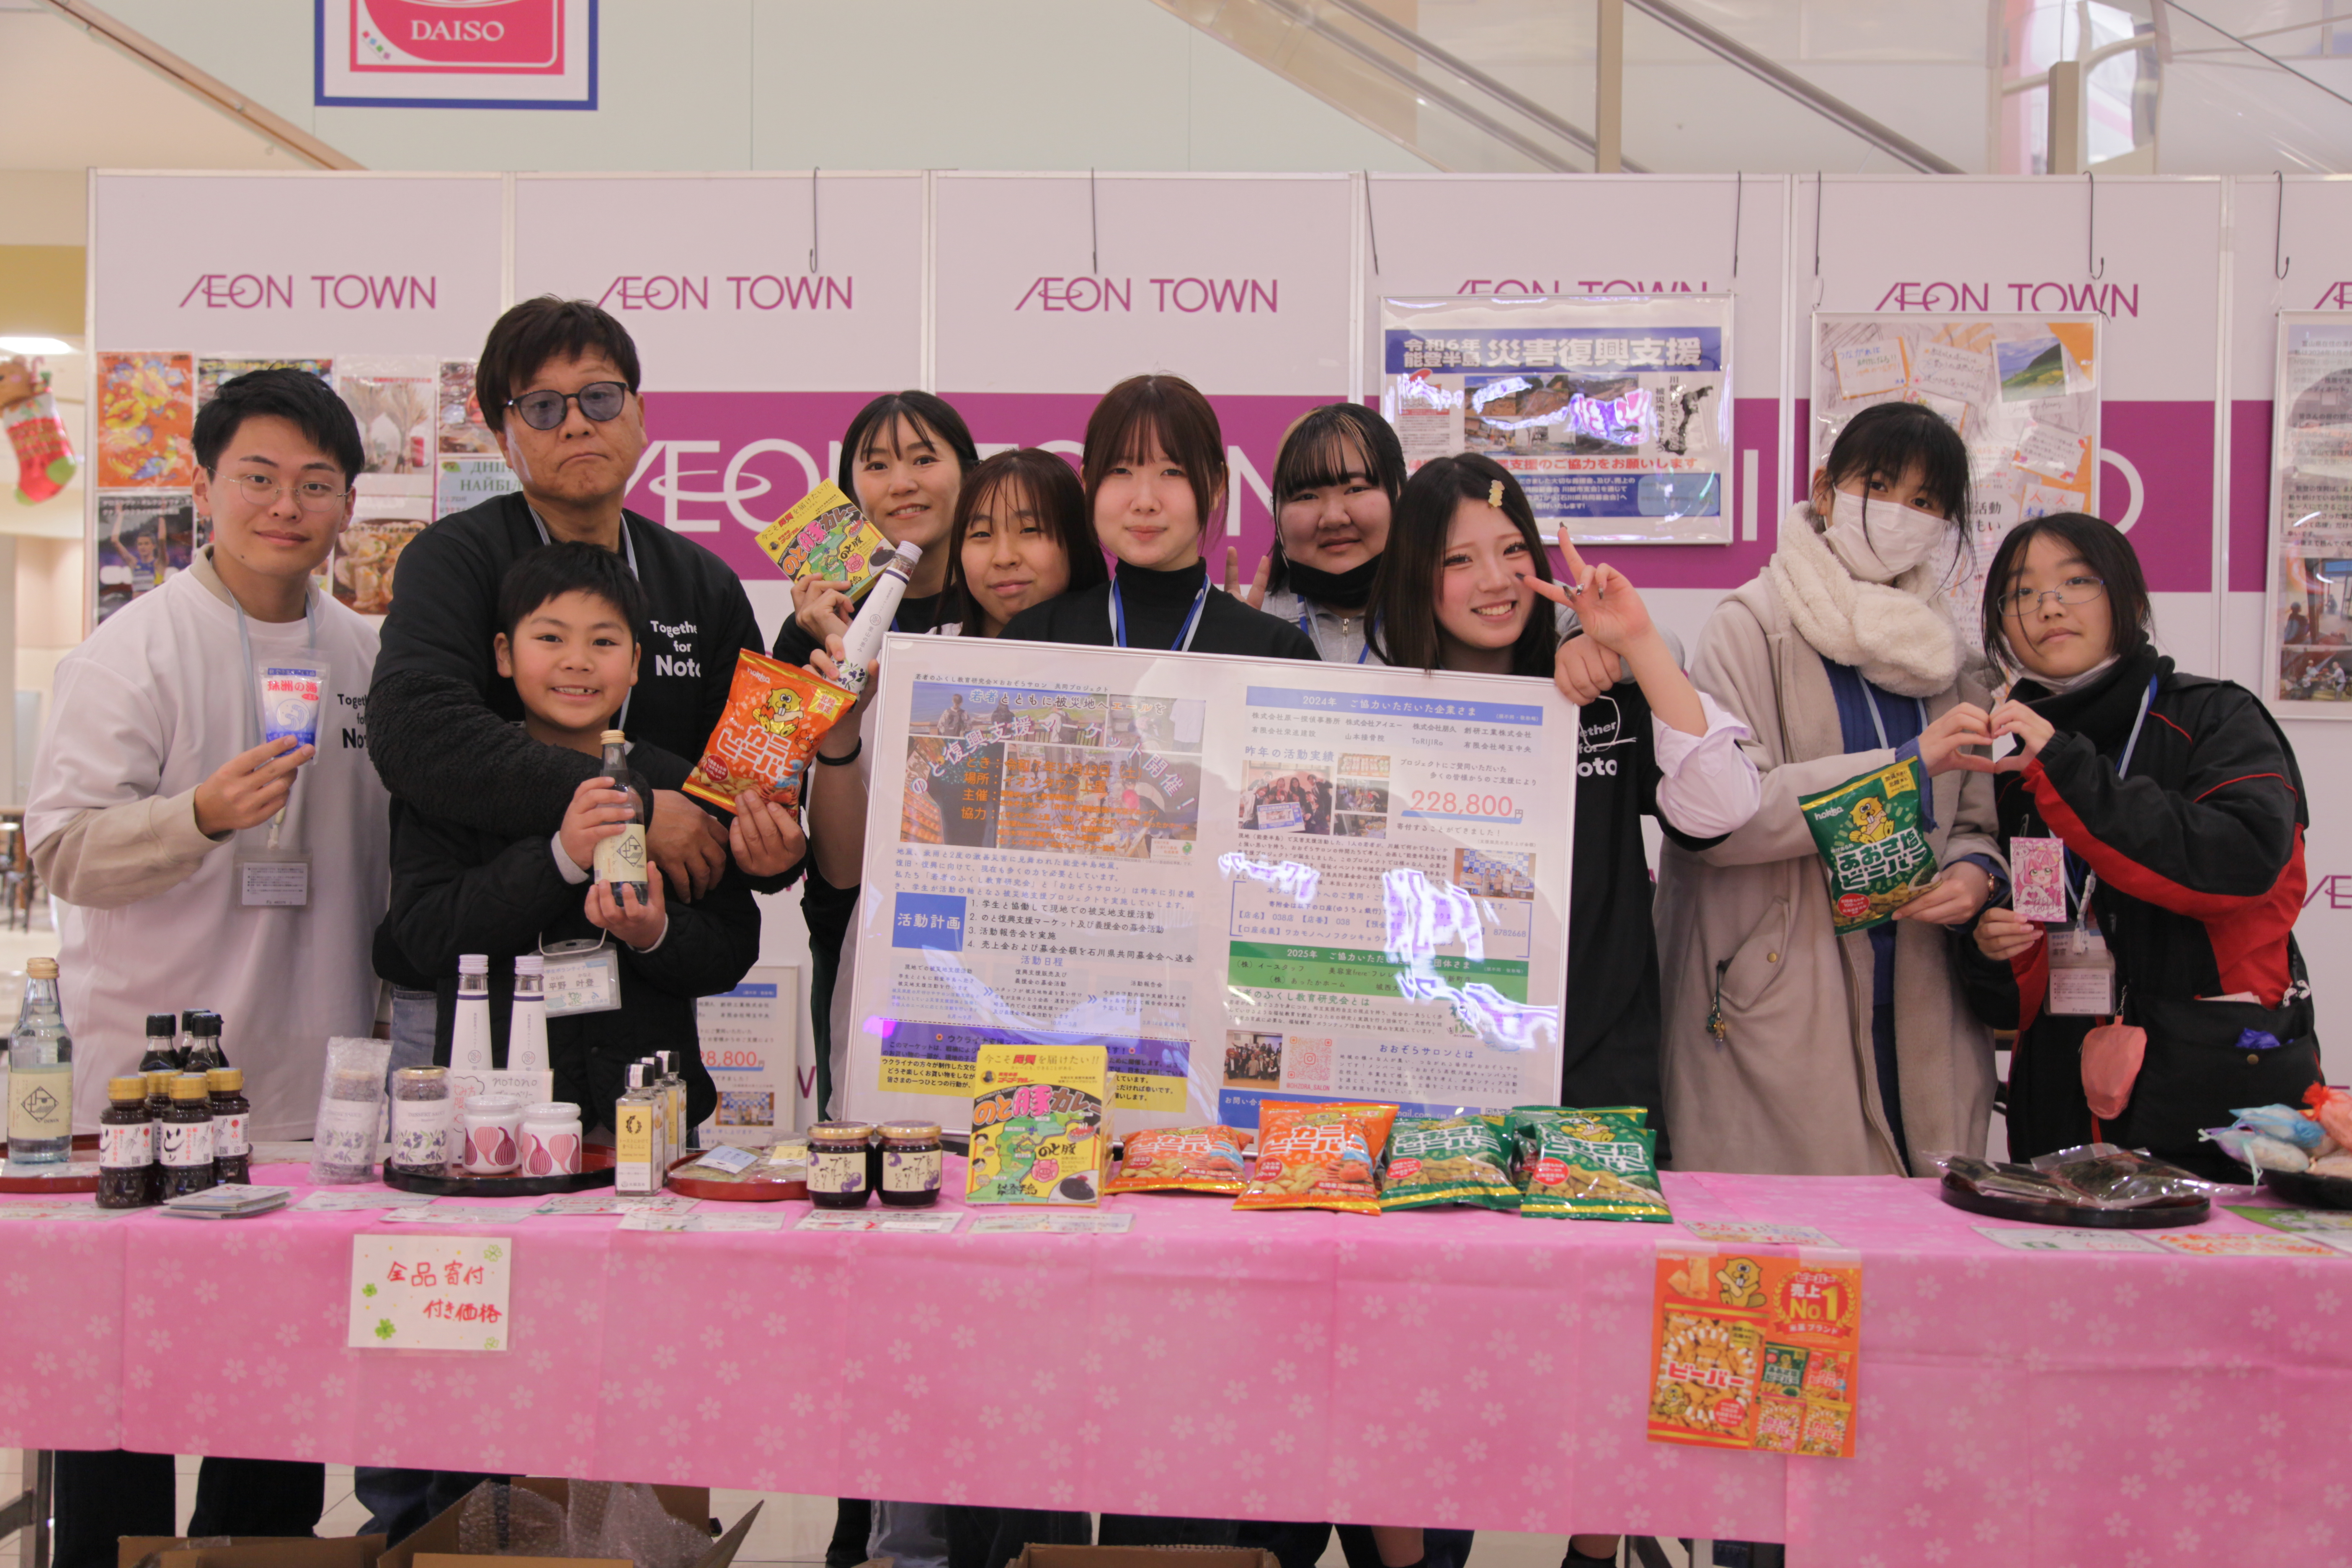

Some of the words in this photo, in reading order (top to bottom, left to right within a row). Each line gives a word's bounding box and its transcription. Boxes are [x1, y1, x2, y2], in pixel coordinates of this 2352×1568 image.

[411, 19, 505, 42] DAISO
[311, 274, 436, 310] TOWN
[726, 275, 853, 310] TOWN
[1150, 277, 1278, 313] TOWN
[2008, 282, 2138, 317] TOWN
[1404, 338, 1480, 351] 令和6年
[1487, 338, 1702, 367] 災害復興支援
[1404, 352, 1481, 367] 能登半島
[782, 505, 859, 575] のと豚カレー
[650, 621, 697, 638] Togethe
[673, 640, 692, 653] for
[747, 666, 771, 684] hokka
[267, 680, 318, 693] 珠洲の海
[1055, 683, 1108, 693] 共同プロジェクト
[815, 702, 835, 715] 限定
[820, 694, 836, 709] 北陸
[969, 689, 1166, 715] 若者とともに被災地へエールを
[1302, 696, 1337, 707] 2024年
[1350, 699, 1476, 717] ご協力いただいた企業さま
[356, 713, 366, 725] fo
[1252, 712, 1341, 725] 株式会社原一探偵事務所
[1345, 718, 1403, 728] 株式会社アイエー
[1413, 723, 1457, 733] 株式会社朋久
[1464, 727, 1532, 738] 創研工業株式会社
[1578, 721, 1617, 739] ether
[1251, 726, 1316, 738] 有限会社栄進建設
[1345, 733, 1385, 742] 山本接骨院
[1464, 741, 1532, 753] 有限会社埼玉中央
[1245, 745, 1335, 762] 昨年の活動実績
[1400, 759, 1507, 773] プロジェクトにご賛同いただいた
[1576, 757, 1617, 777] oto
[964, 771, 1107, 794] 場所：イオンタウン上里
[1430, 771, 1537, 786] 多くの皆様からのご支援により
[1410, 789, 1524, 819] 228,800円
[1814, 805, 1844, 821] hokka
[1397, 823, 1501, 837] 寄付することができました！
[982, 900, 1155, 920] 学生と協働して現地での被災地支援活動
[897, 912, 961, 930] 活動計画
[982, 914, 1164, 934] のと復興支援マーケット及び義援金の募金活動
[1272, 913, 1294, 922] 038店
[1493, 929, 1526, 938] 8782668
[980, 926, 1057, 941] 活動報告会を実施
[981, 940, 1194, 963] 売上金および募金全額を石川県共同募金会へ送金
[1287, 949, 1318, 959] 2025年
[1020, 955, 1064, 967] 活動日程
[904, 964, 973, 975] 現地での被災地支援活動
[1015, 968, 1067, 978] 復興支援販売及び
[549, 981, 567, 990] 平野
[576, 978, 594, 988] 叶登
[897, 980, 969, 990] 被災地支援活動を行います
[1015, 977, 1067, 988] 義援金の募金活動
[1130, 980, 1163, 988] 活動報告会
[1380, 1044, 1474, 1059] おおぞらサロンとは
[882, 1058, 976, 1071] ウクライナの方々が制作した文化
[492, 1076, 537, 1088] notono
[887, 1068, 975, 1080] どうぞ楽しくお買い物をしなが
[887, 1076, 972, 1088] 皆さまの一つひとつの行動が、
[973, 1084, 1102, 1126] のと豚カレー
[1396, 1109, 1431, 1119] mail.com
[1038, 1142, 1076, 1157] のと豚
[387, 1260, 484, 1287] 全品寄付
[1790, 1283, 1821, 1298] 売上
[423, 1299, 503, 1323] 付き価格
[1790, 1285, 1839, 1321] No.1
[1667, 1361, 1746, 1387] ビーバー
